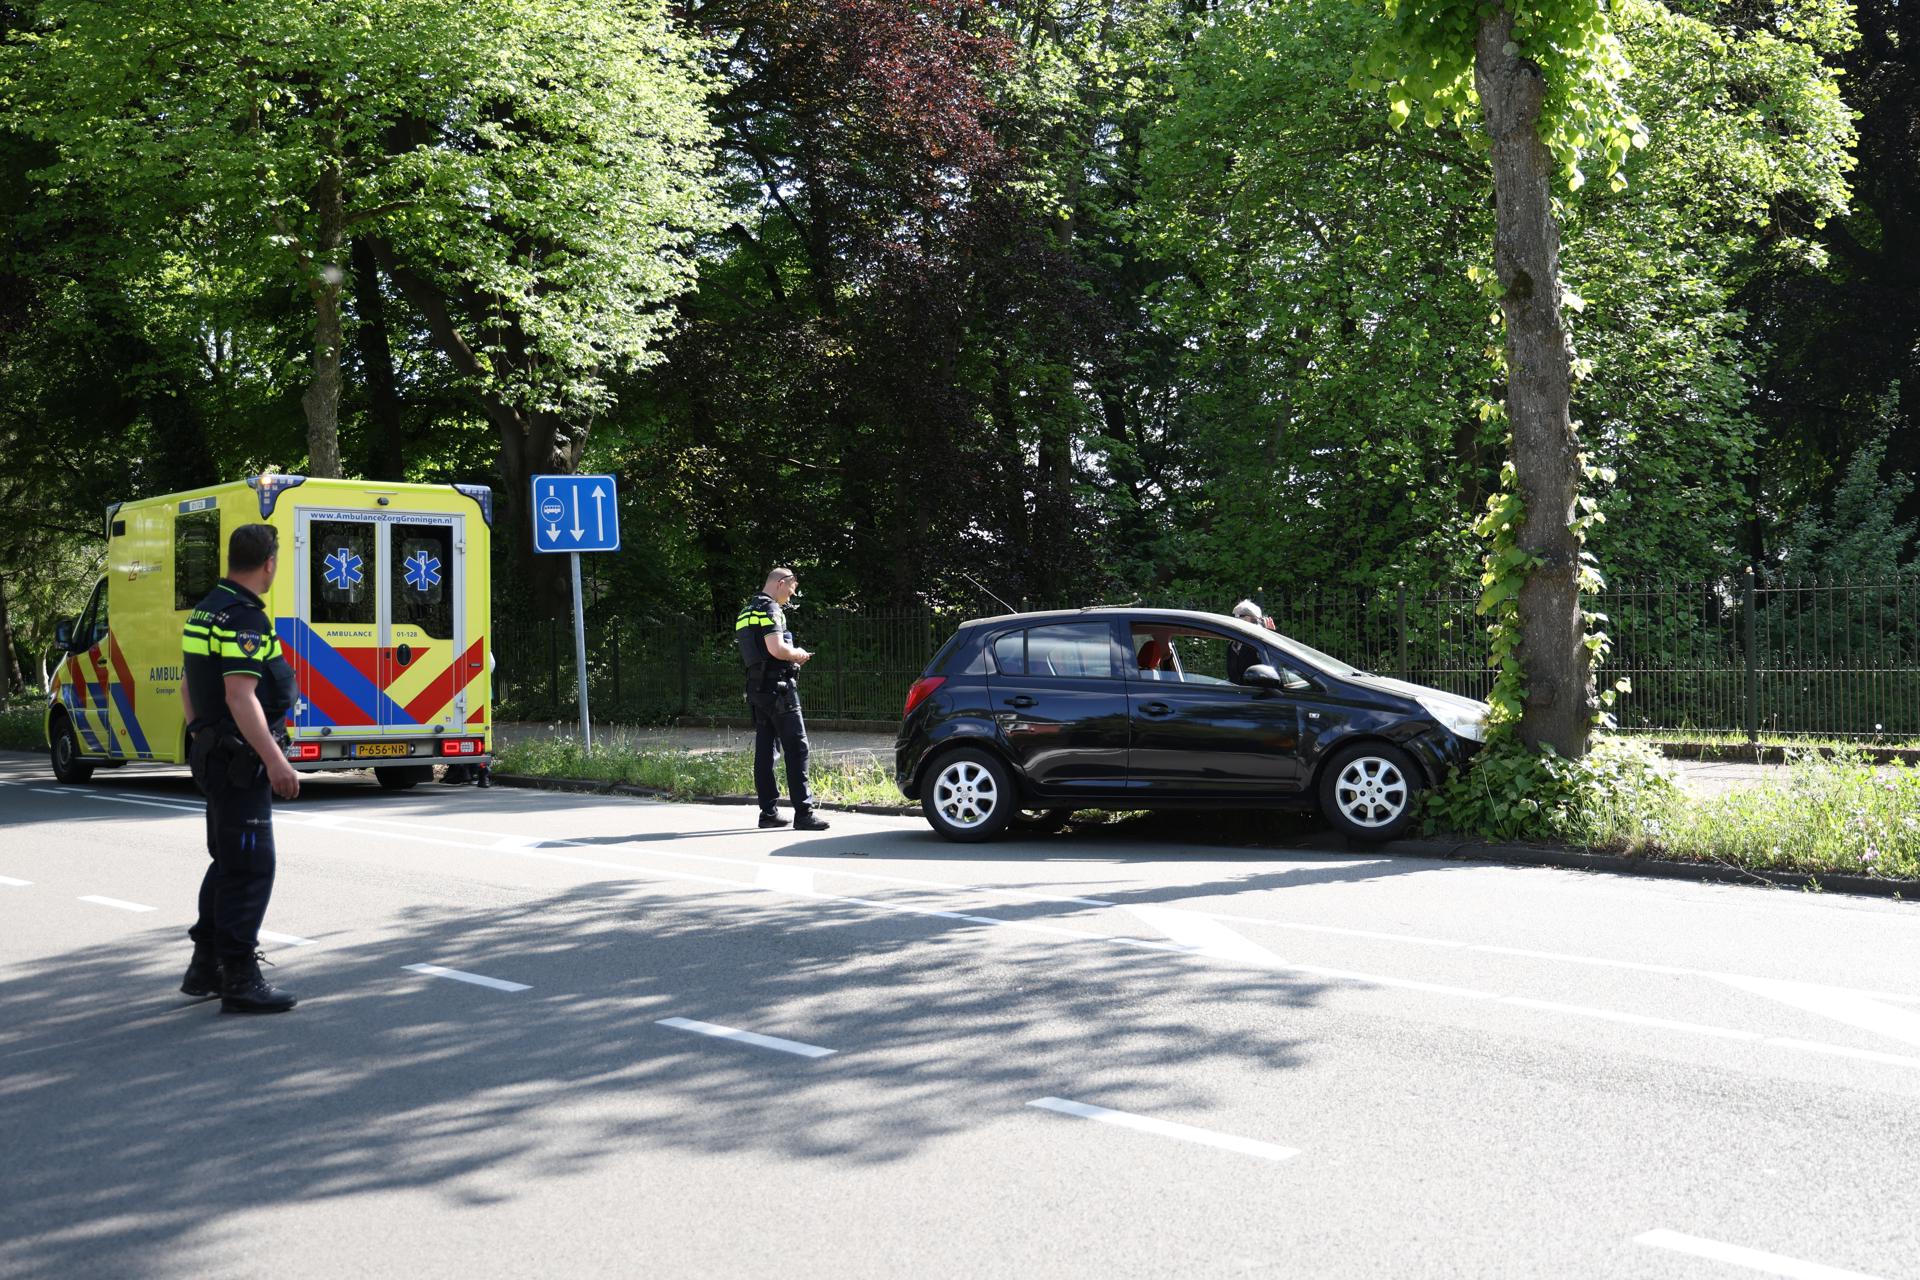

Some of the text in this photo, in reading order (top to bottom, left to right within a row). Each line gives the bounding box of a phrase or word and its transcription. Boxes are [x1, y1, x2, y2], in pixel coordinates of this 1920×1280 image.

[310, 512, 452, 524] www.AmbulanceZorgGroningen.nl
[150, 666, 185, 681] AMBULA
[359, 745, 405, 755] P-656-NR
